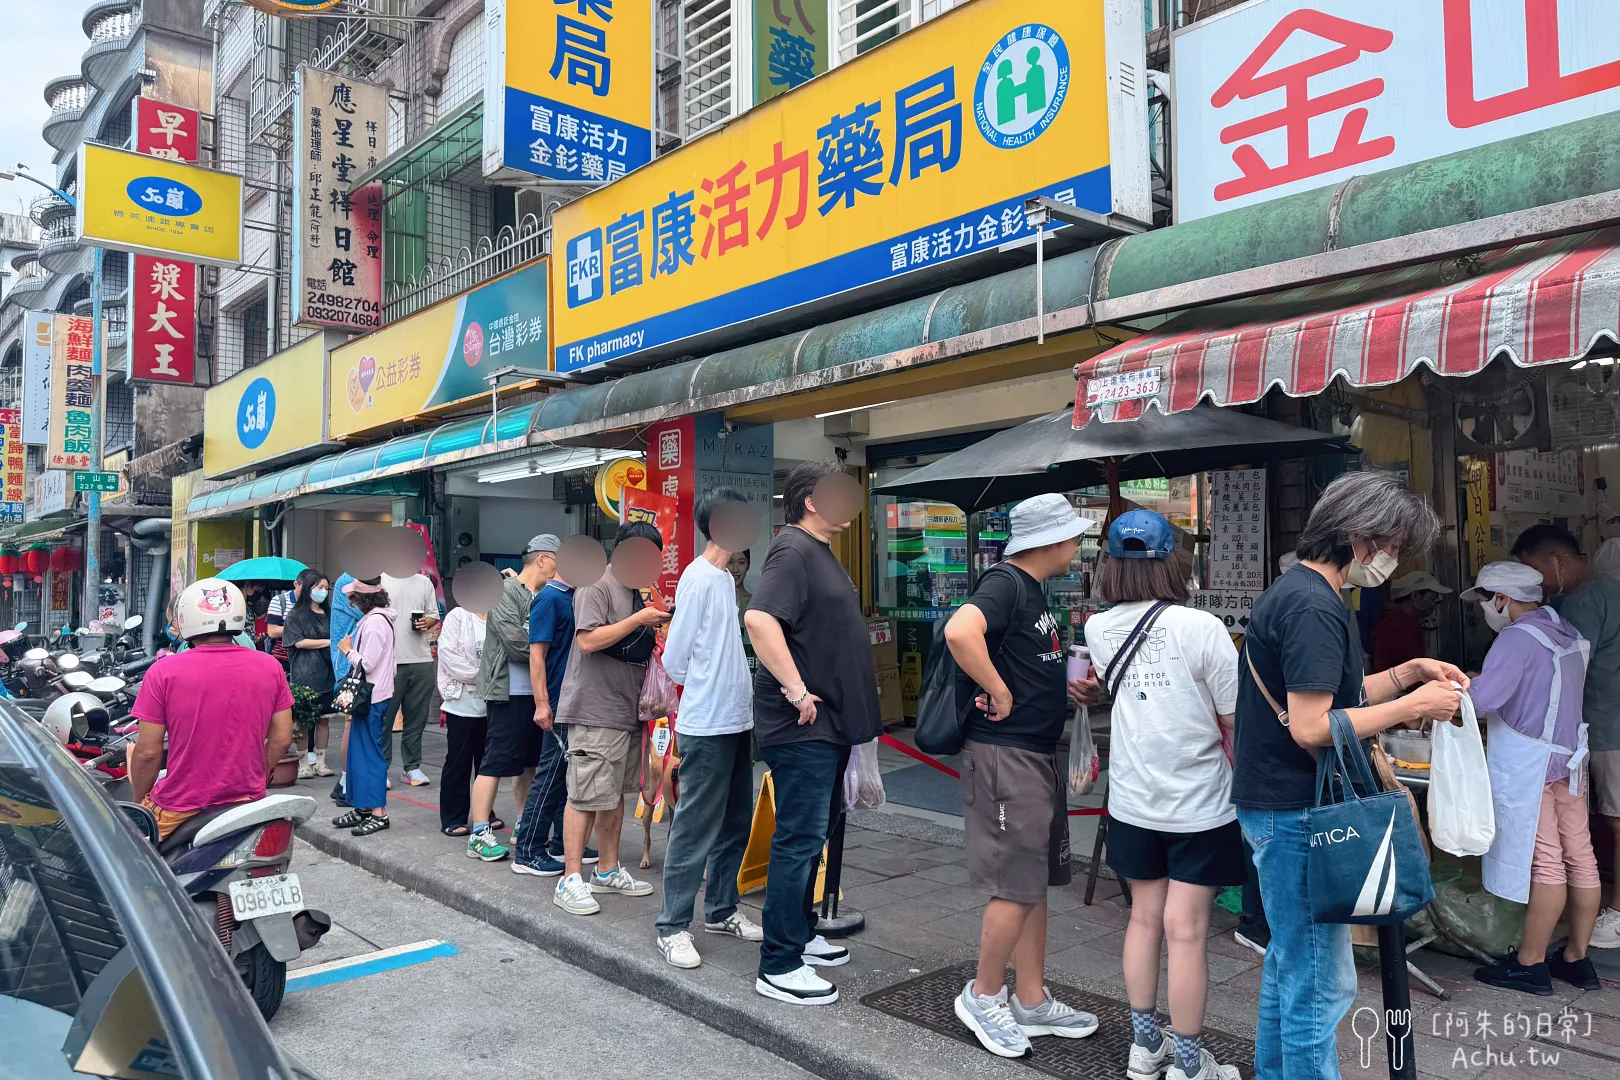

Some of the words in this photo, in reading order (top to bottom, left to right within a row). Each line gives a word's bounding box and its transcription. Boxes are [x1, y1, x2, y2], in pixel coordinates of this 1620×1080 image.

[548, 0, 614, 97] 局
[982, 26, 1059, 74] 全民健康保險
[976, 101, 998, 143] NATIONAL
[1002, 129, 1036, 146] HEALTH
[1040, 66, 1068, 129] INSURANCE
[529, 105, 628, 157] 富康活力
[328, 82, 357, 287] 應星堂擇日館
[605, 66, 963, 297] 富康活力藥局
[307, 278, 327, 291] 電話
[308, 292, 379, 313] 24982704
[147, 262, 186, 377] 漿大王
[308, 306, 380, 327] 0932074684
[489, 316, 542, 356] 台灣彩券
[67, 318, 93, 362] 海鮮麵
[569, 345, 585, 364] FK
[587, 329, 645, 362] pharmacy
[376, 352, 420, 390] 公益彩券
[64, 410, 91, 453] 魯肉飯
[661, 433, 678, 465] 藥
[703, 439, 768, 458] MORAZ
[7, 425, 24, 501] 當歸鴨麵線
[77, 475, 116, 483] 中山路
[1193, 593, 1254, 610] 排隊方向
